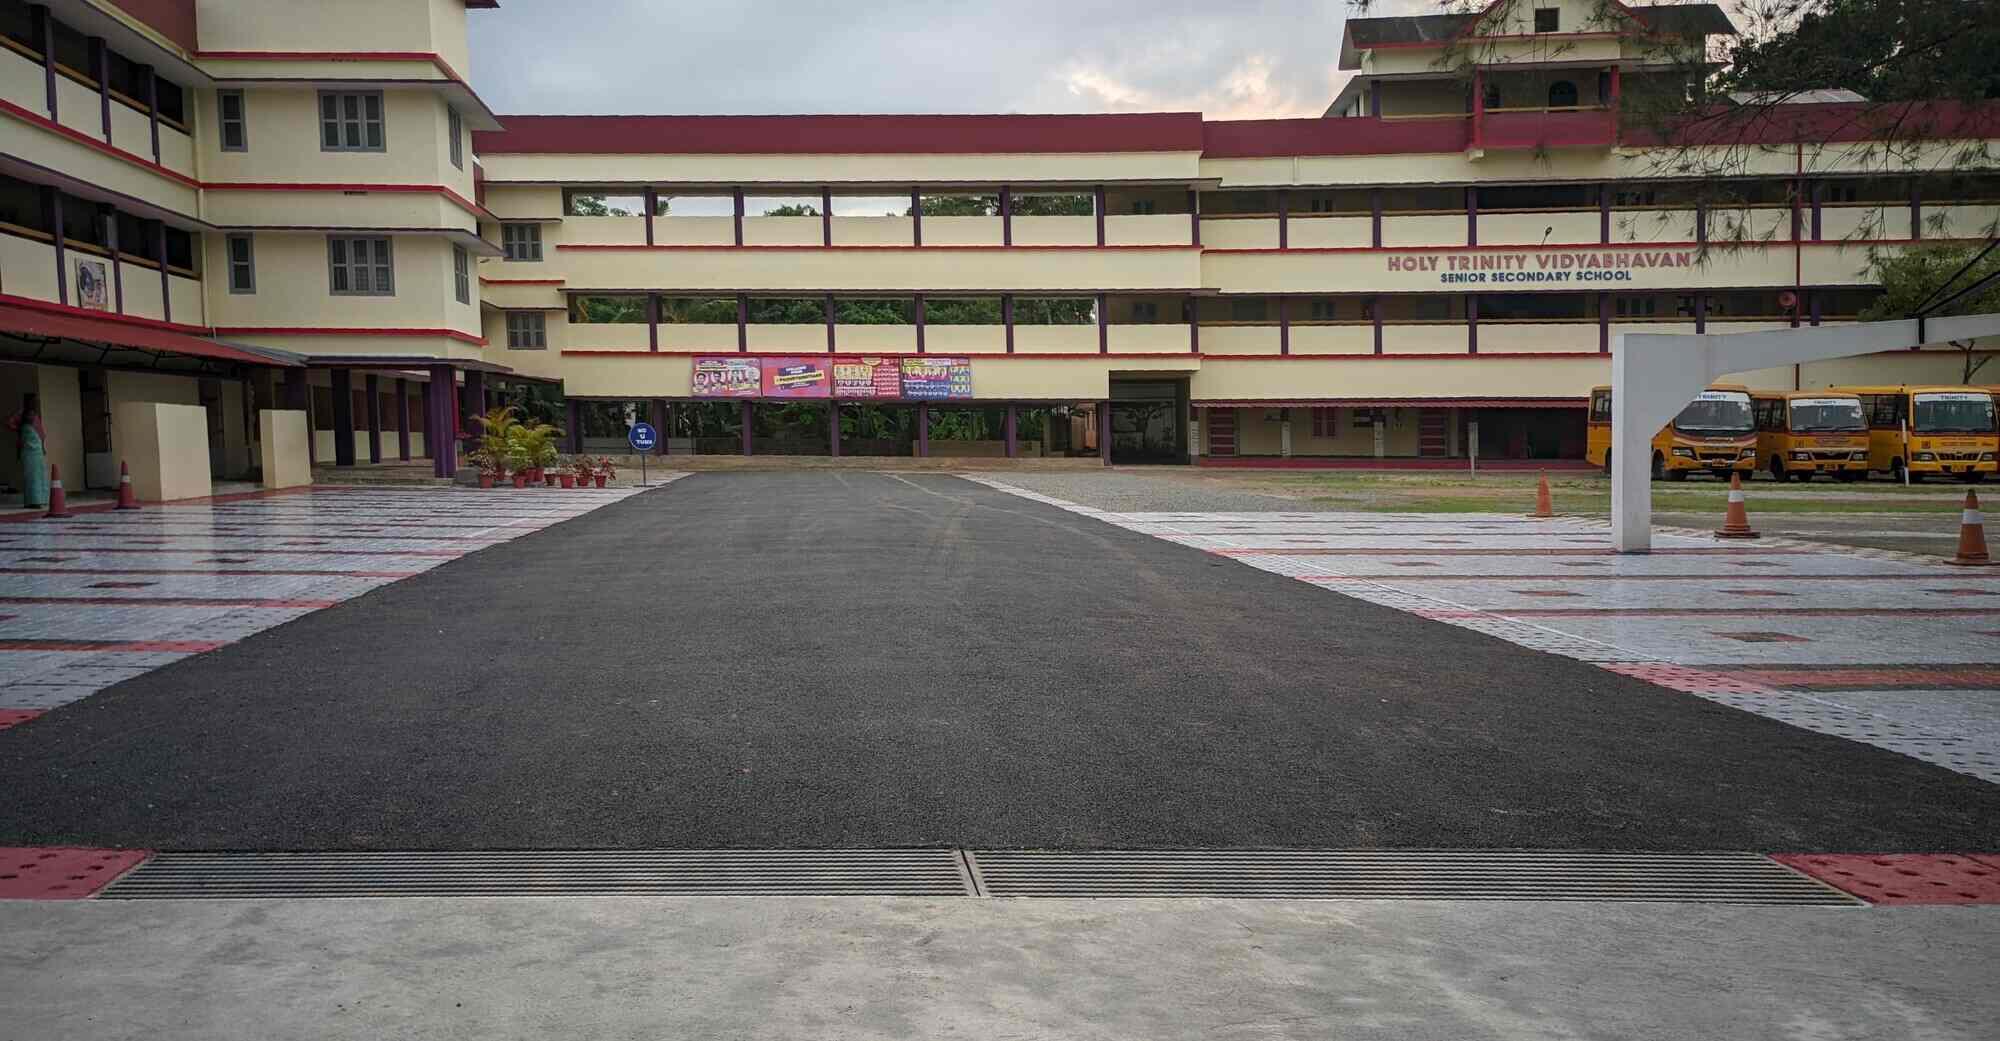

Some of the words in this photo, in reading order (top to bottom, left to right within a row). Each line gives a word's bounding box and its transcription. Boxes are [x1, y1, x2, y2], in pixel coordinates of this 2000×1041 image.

[1388, 256, 1439, 271] HOLY
[1447, 255, 1527, 270] TRINITY
[1536, 252, 1691, 269] VIDYABHAVAN
[1440, 272, 1486, 283] SENIOR
[1491, 271, 1571, 282] SECONDARY
[1576, 270, 1632, 281] SCHOOL
